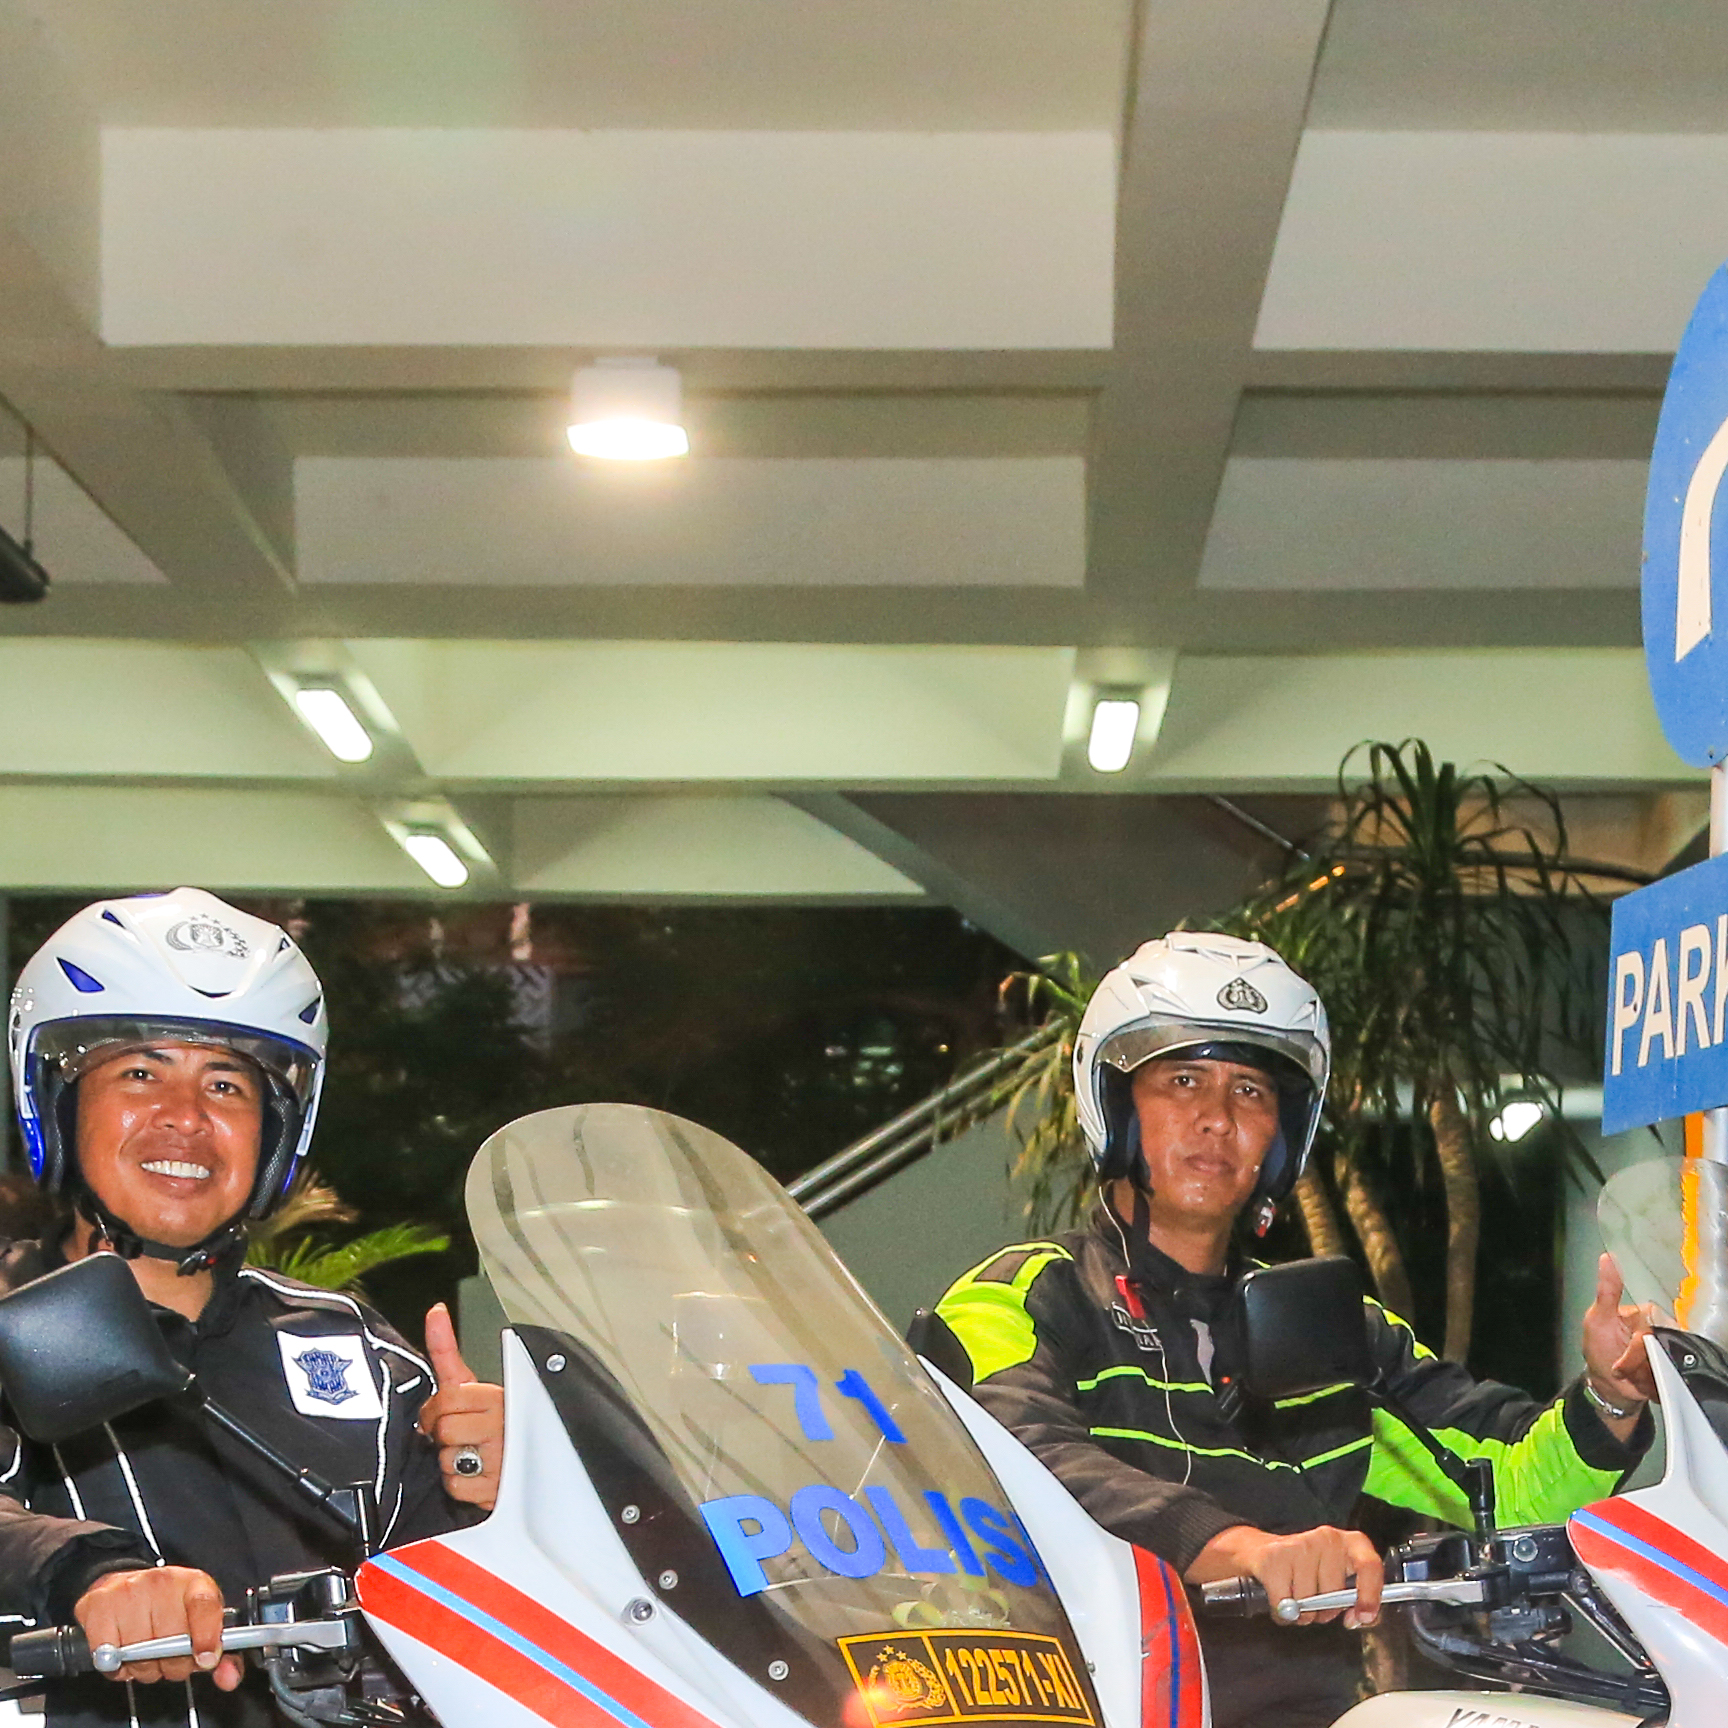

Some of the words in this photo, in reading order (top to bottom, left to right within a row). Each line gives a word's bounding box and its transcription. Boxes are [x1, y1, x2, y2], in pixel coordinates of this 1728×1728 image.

[746, 1363, 908, 1445] 71
[698, 1484, 1058, 1598] POLIS
[945, 1647, 1082, 1710] 122571-XI
